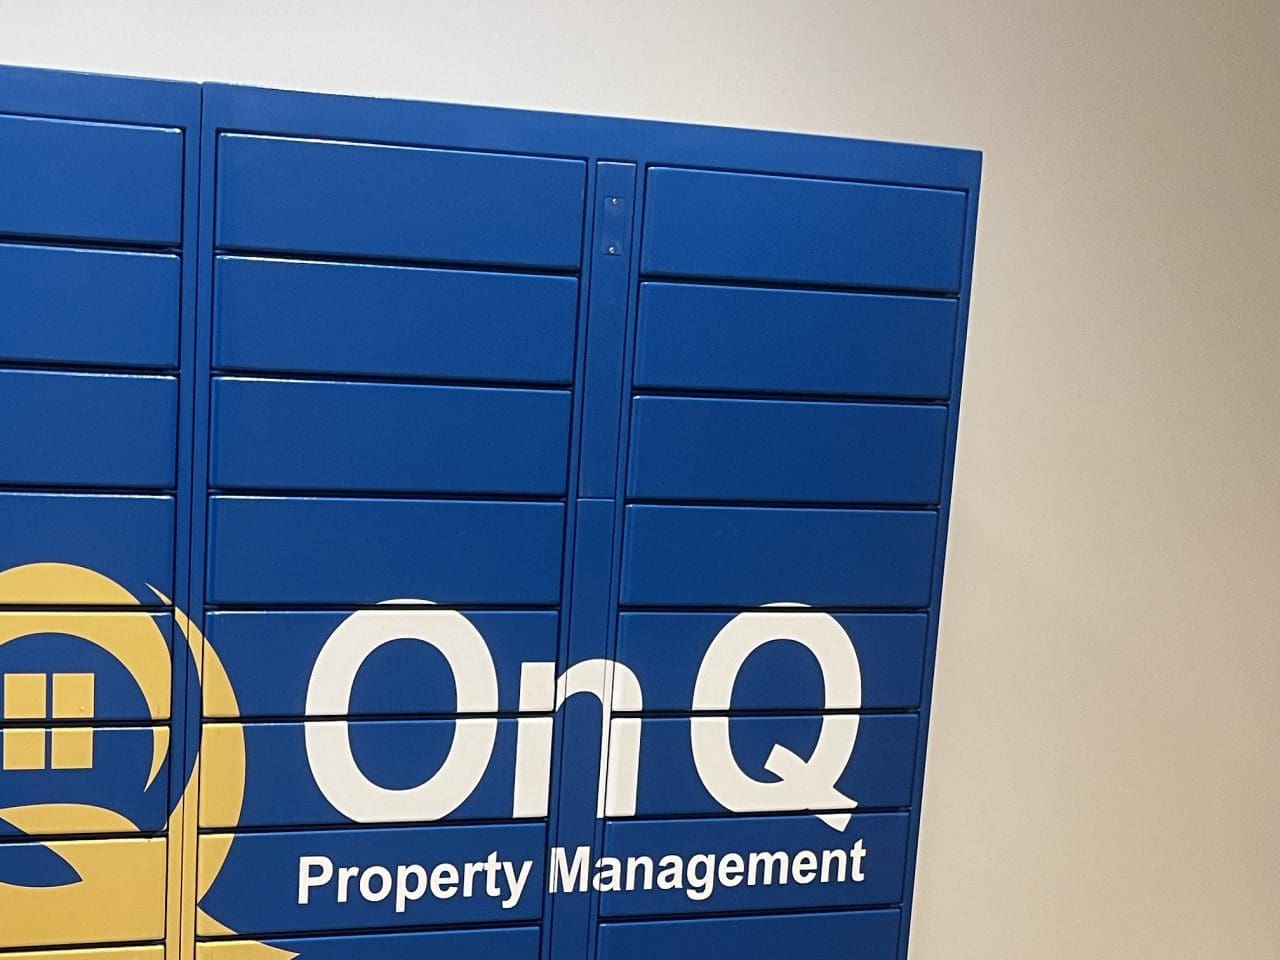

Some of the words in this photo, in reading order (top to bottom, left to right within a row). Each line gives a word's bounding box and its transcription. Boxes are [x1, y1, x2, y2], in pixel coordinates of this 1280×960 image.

[304, 598, 643, 823] On
[691, 602, 862, 832] Q
[298, 851, 532, 912] Property
[549, 838, 867, 900] Management
